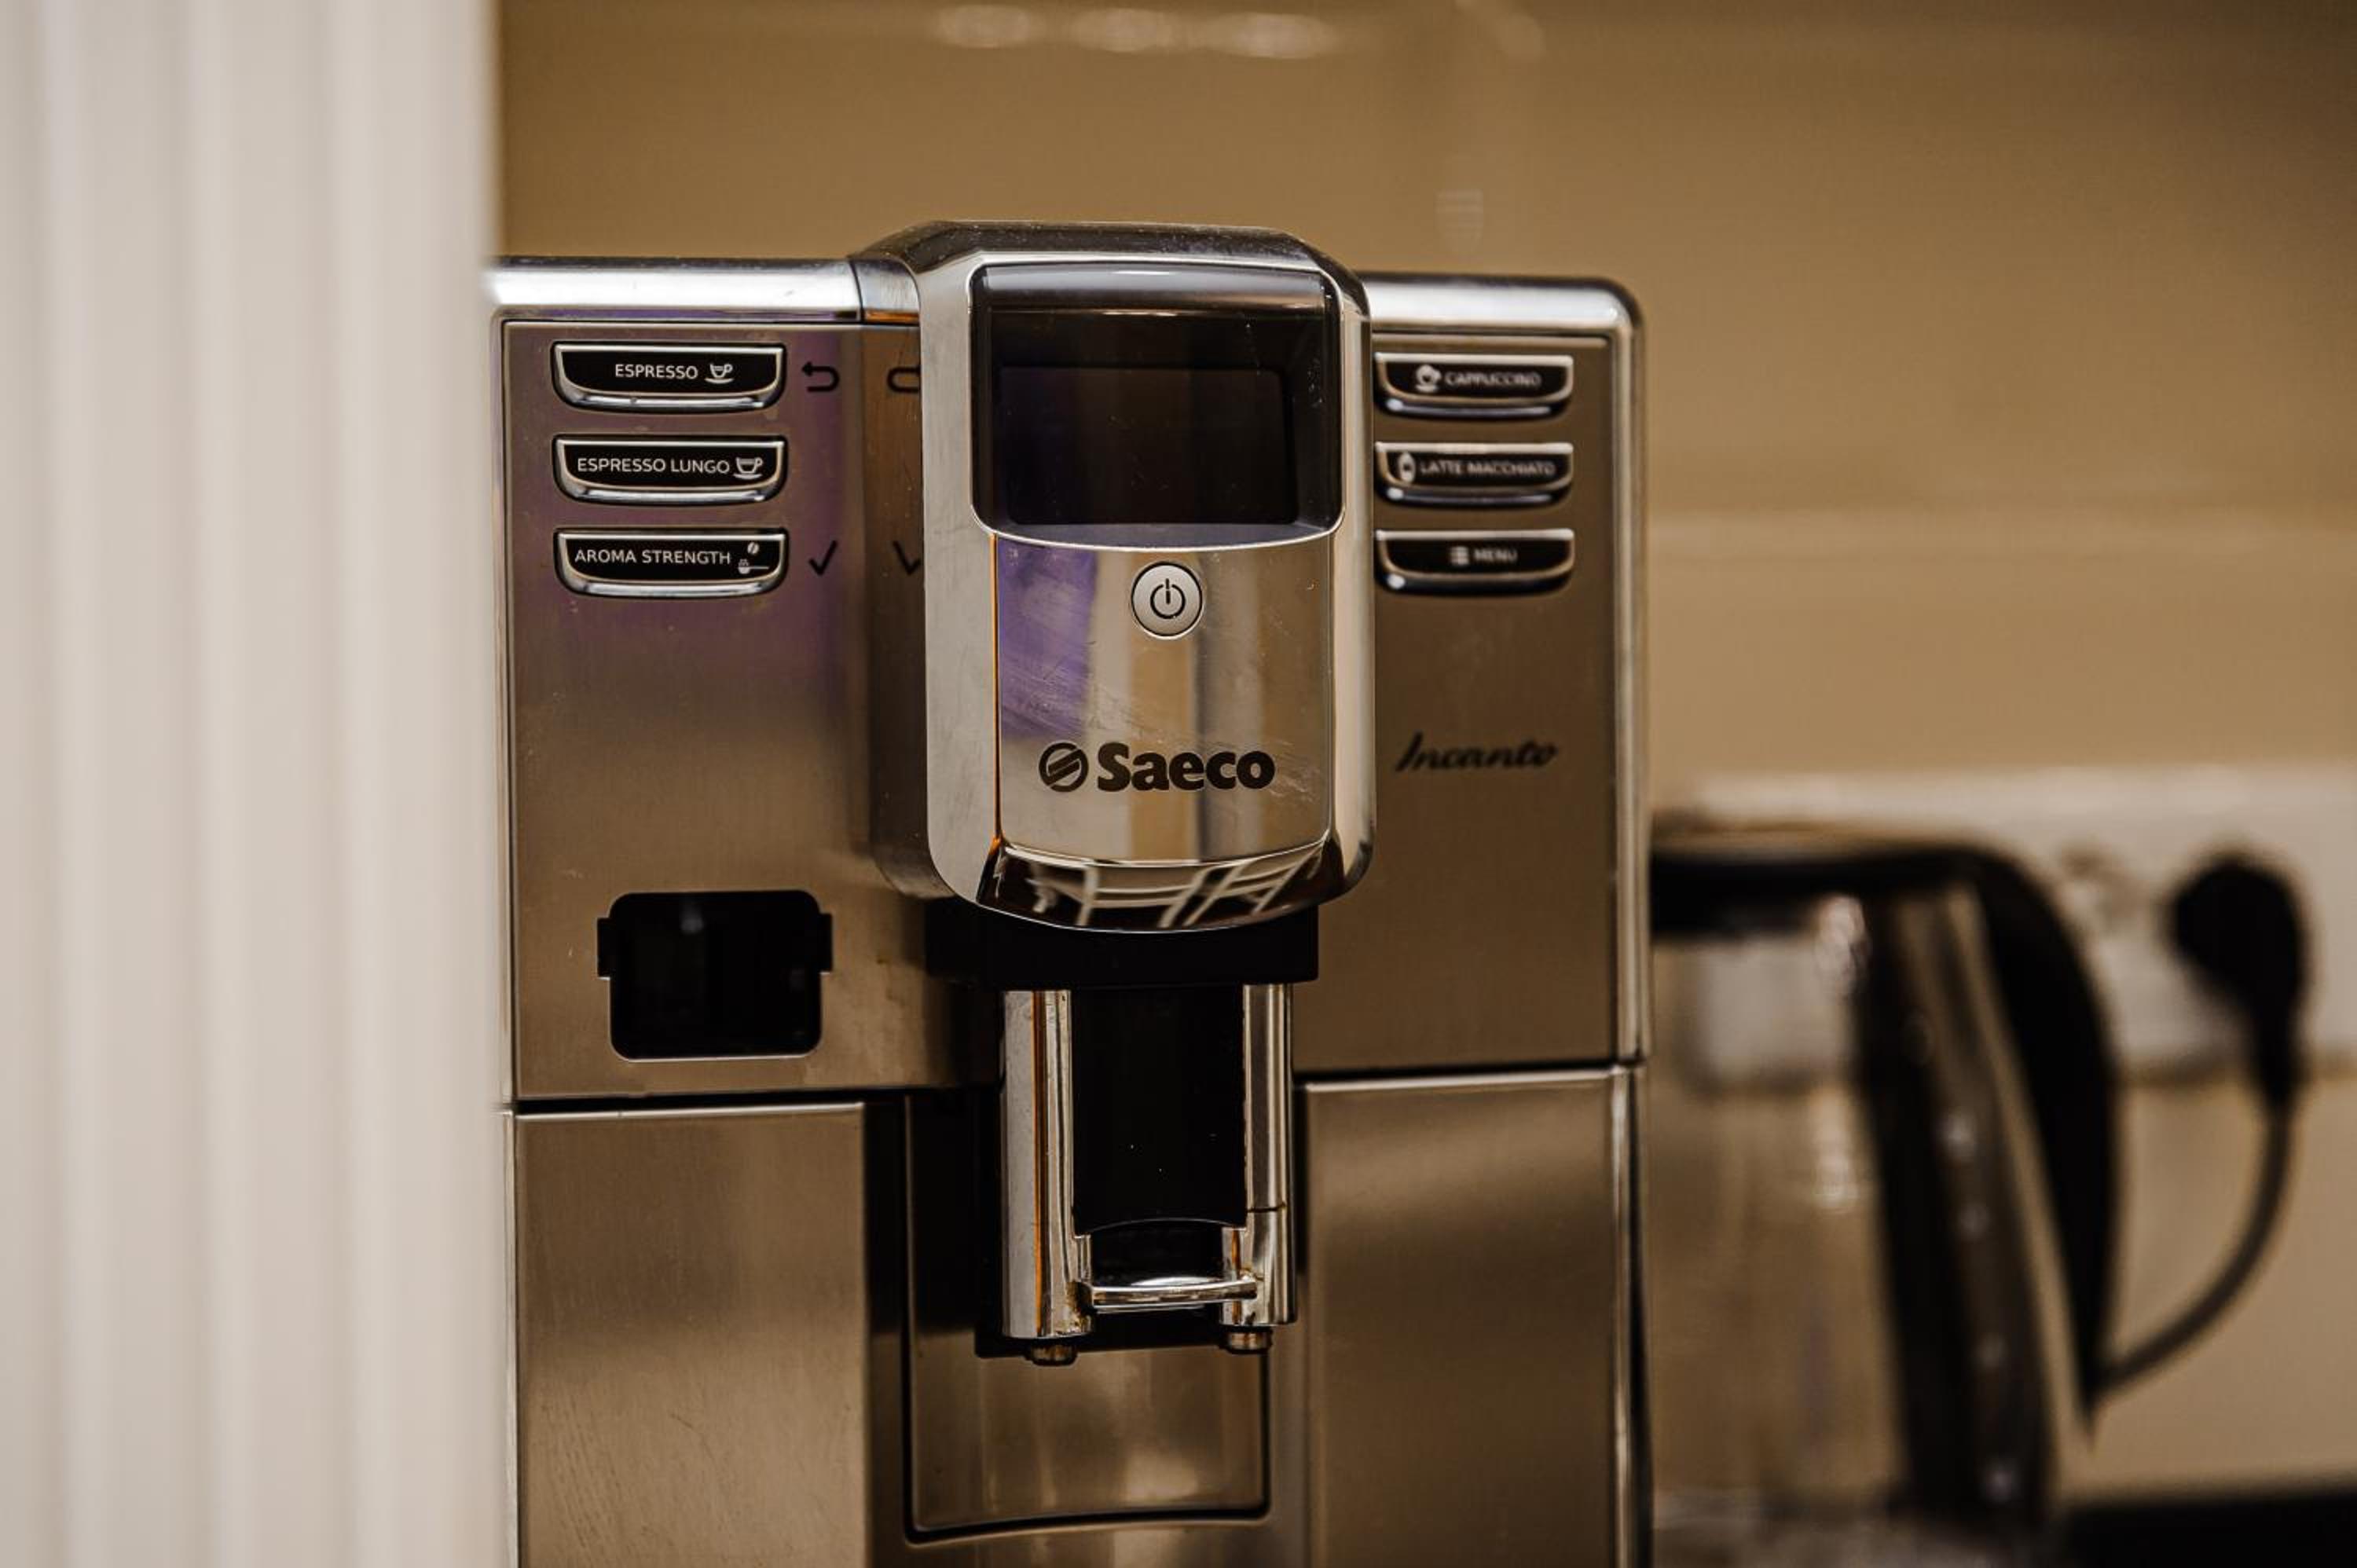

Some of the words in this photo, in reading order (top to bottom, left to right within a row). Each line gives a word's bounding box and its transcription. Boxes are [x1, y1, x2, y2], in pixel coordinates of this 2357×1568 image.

[615, 364, 698, 379] ESPRESSO
[1444, 372, 1542, 387] CAPPUCCINO
[577, 458, 665, 472] ESPRESSO
[670, 459, 730, 474] LUNGO
[1420, 460, 1462, 475] LATTE
[1467, 460, 1556, 476] MACCHIATO
[575, 549, 636, 565] AROMA
[642, 550, 731, 566] STRENGTH
[1474, 549, 1518, 562] MENU
[1395, 732, 1560, 772] Incanto
[1097, 742, 1275, 792] Saeco
